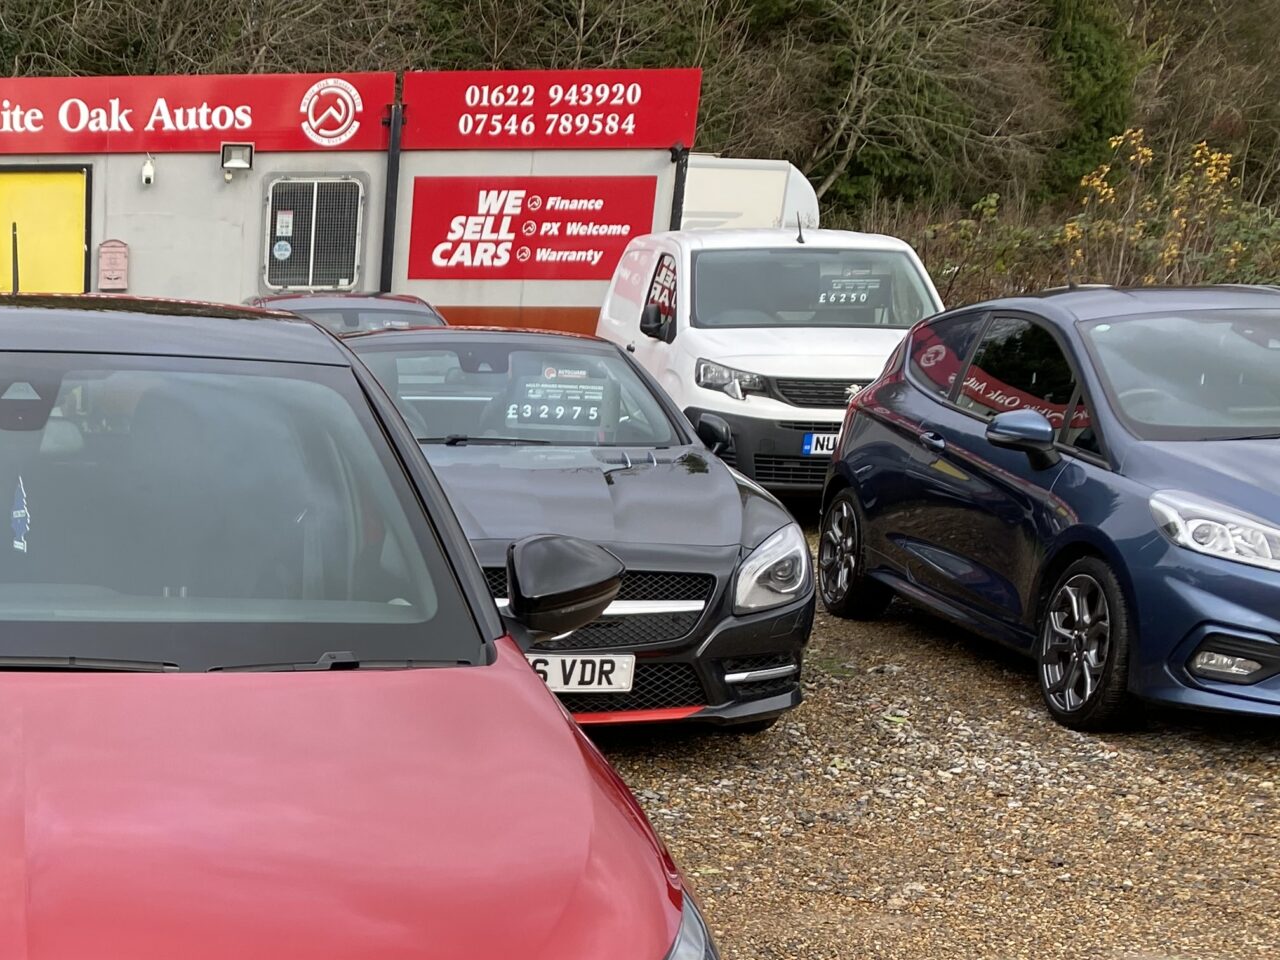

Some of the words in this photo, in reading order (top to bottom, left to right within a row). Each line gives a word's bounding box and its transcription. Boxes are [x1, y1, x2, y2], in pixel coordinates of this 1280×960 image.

[465, 85, 535, 107] 01622
[549, 83, 642, 107] 943920
[58, 98, 134, 133] Oak
[144, 98, 252, 131] Autos
[458, 113, 535, 136] 07546
[545, 113, 636, 136] 789584
[477, 190, 526, 214] WE
[545, 196, 604, 211] Finance
[446, 216, 516, 241] SELL
[539, 222, 561, 236] PX
[566, 221, 631, 236] Welcome
[431, 242, 512, 267] CARS
[535, 247, 603, 265] Warranty
[819, 293, 867, 303] £6250
[507, 403, 599, 420] £32975
[561, 658, 616, 686] VDR
